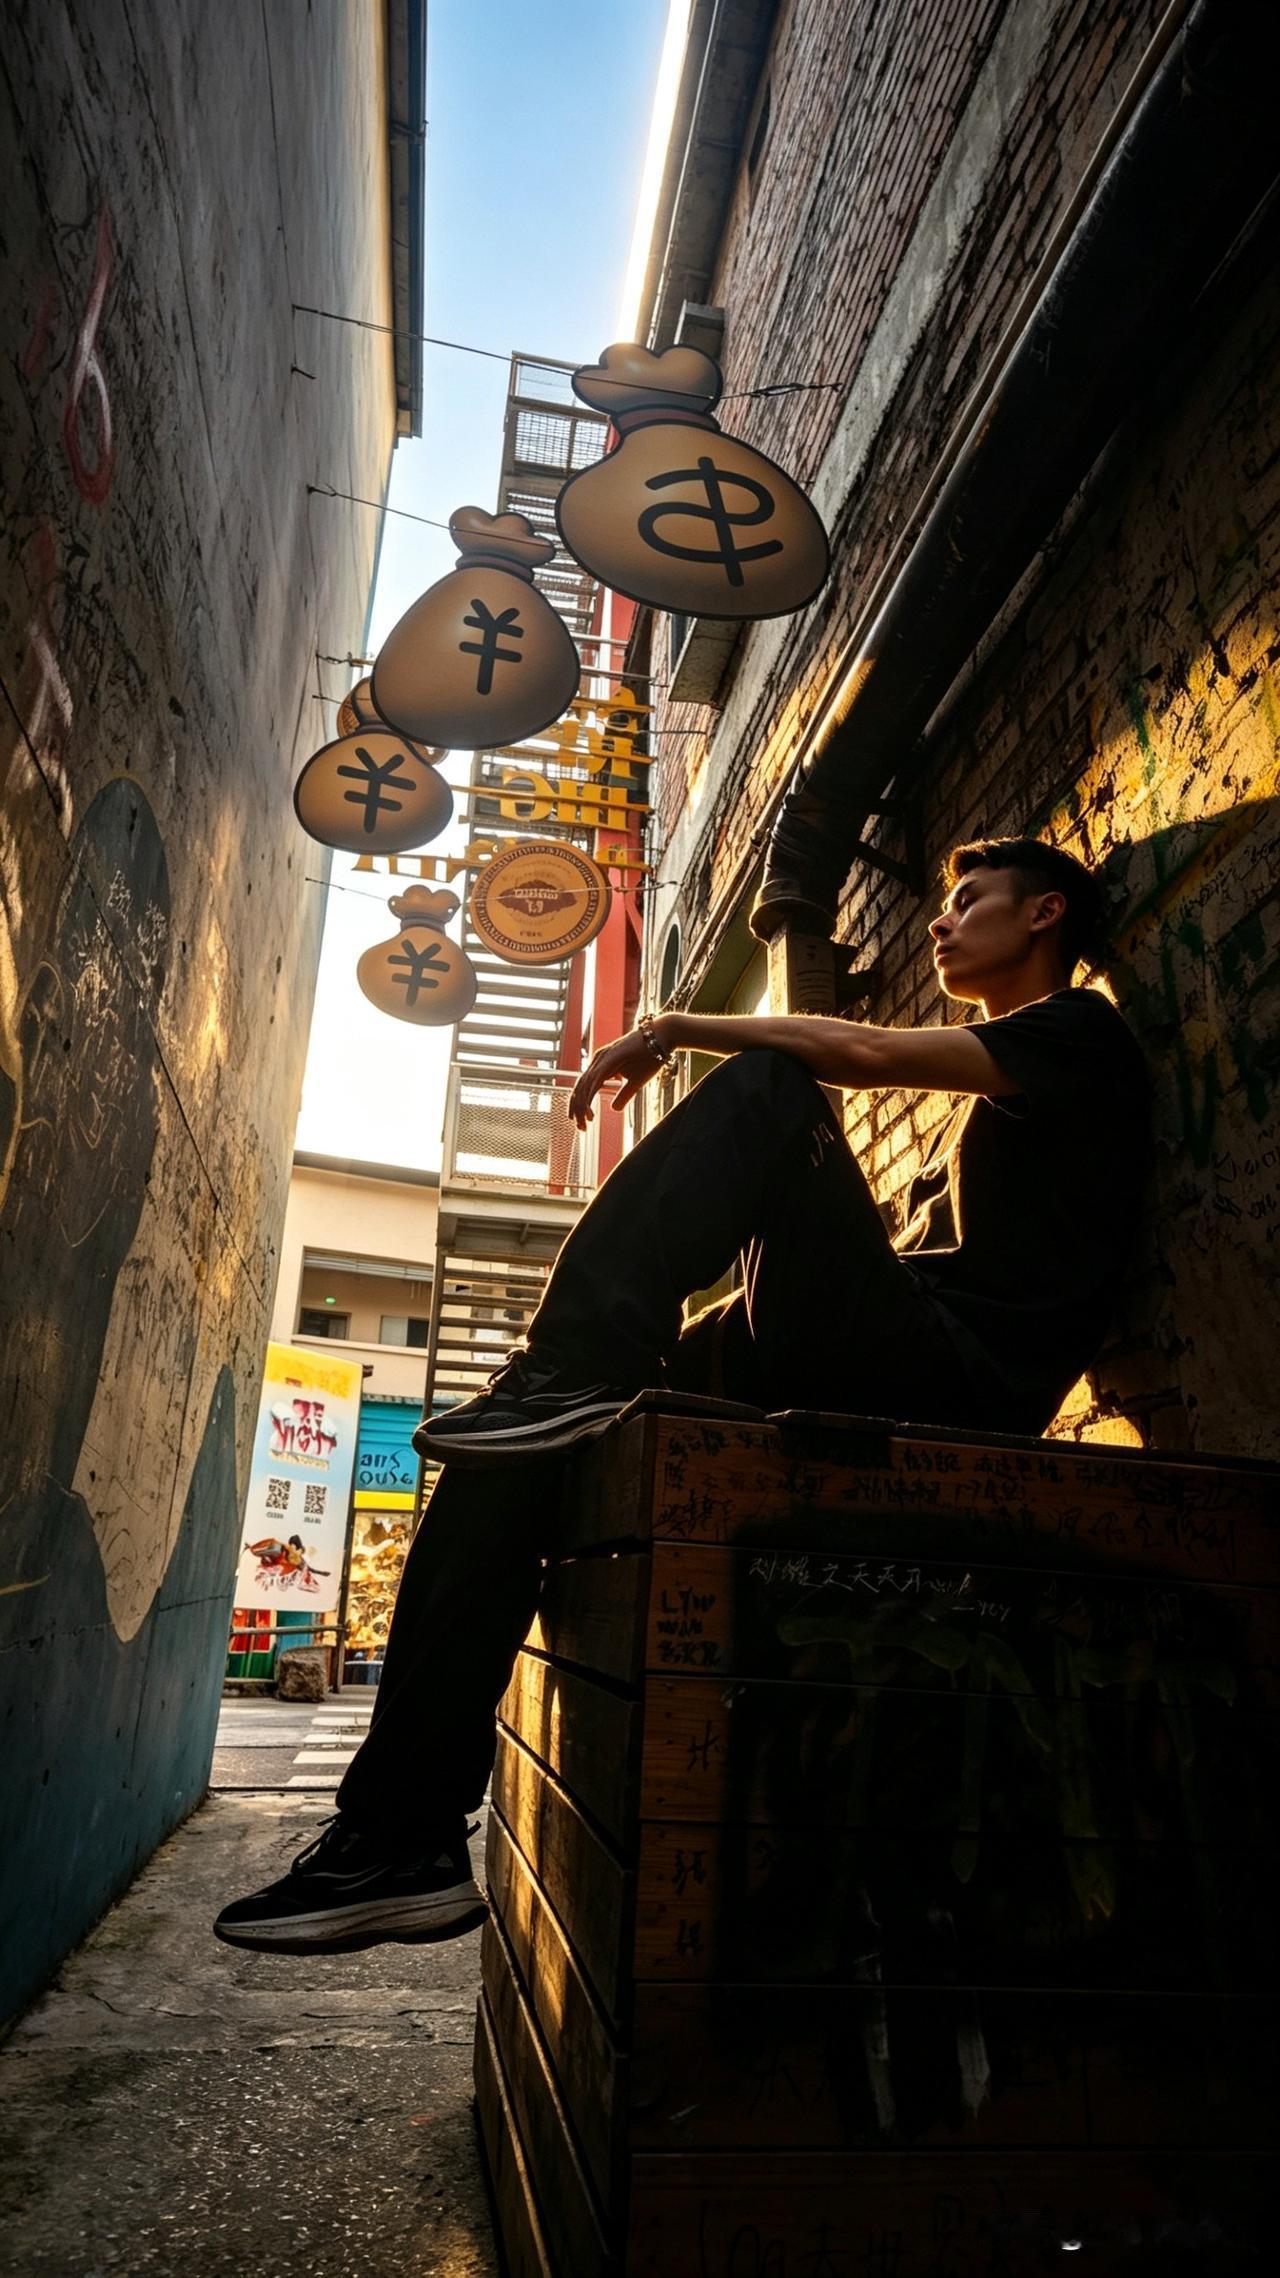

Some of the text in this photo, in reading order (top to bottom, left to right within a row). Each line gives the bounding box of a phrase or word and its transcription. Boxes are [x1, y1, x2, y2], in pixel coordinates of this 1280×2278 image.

[458, 598, 524, 696] ¥
[336, 746, 418, 835] ¥
[386, 938, 452, 1007] ¥
